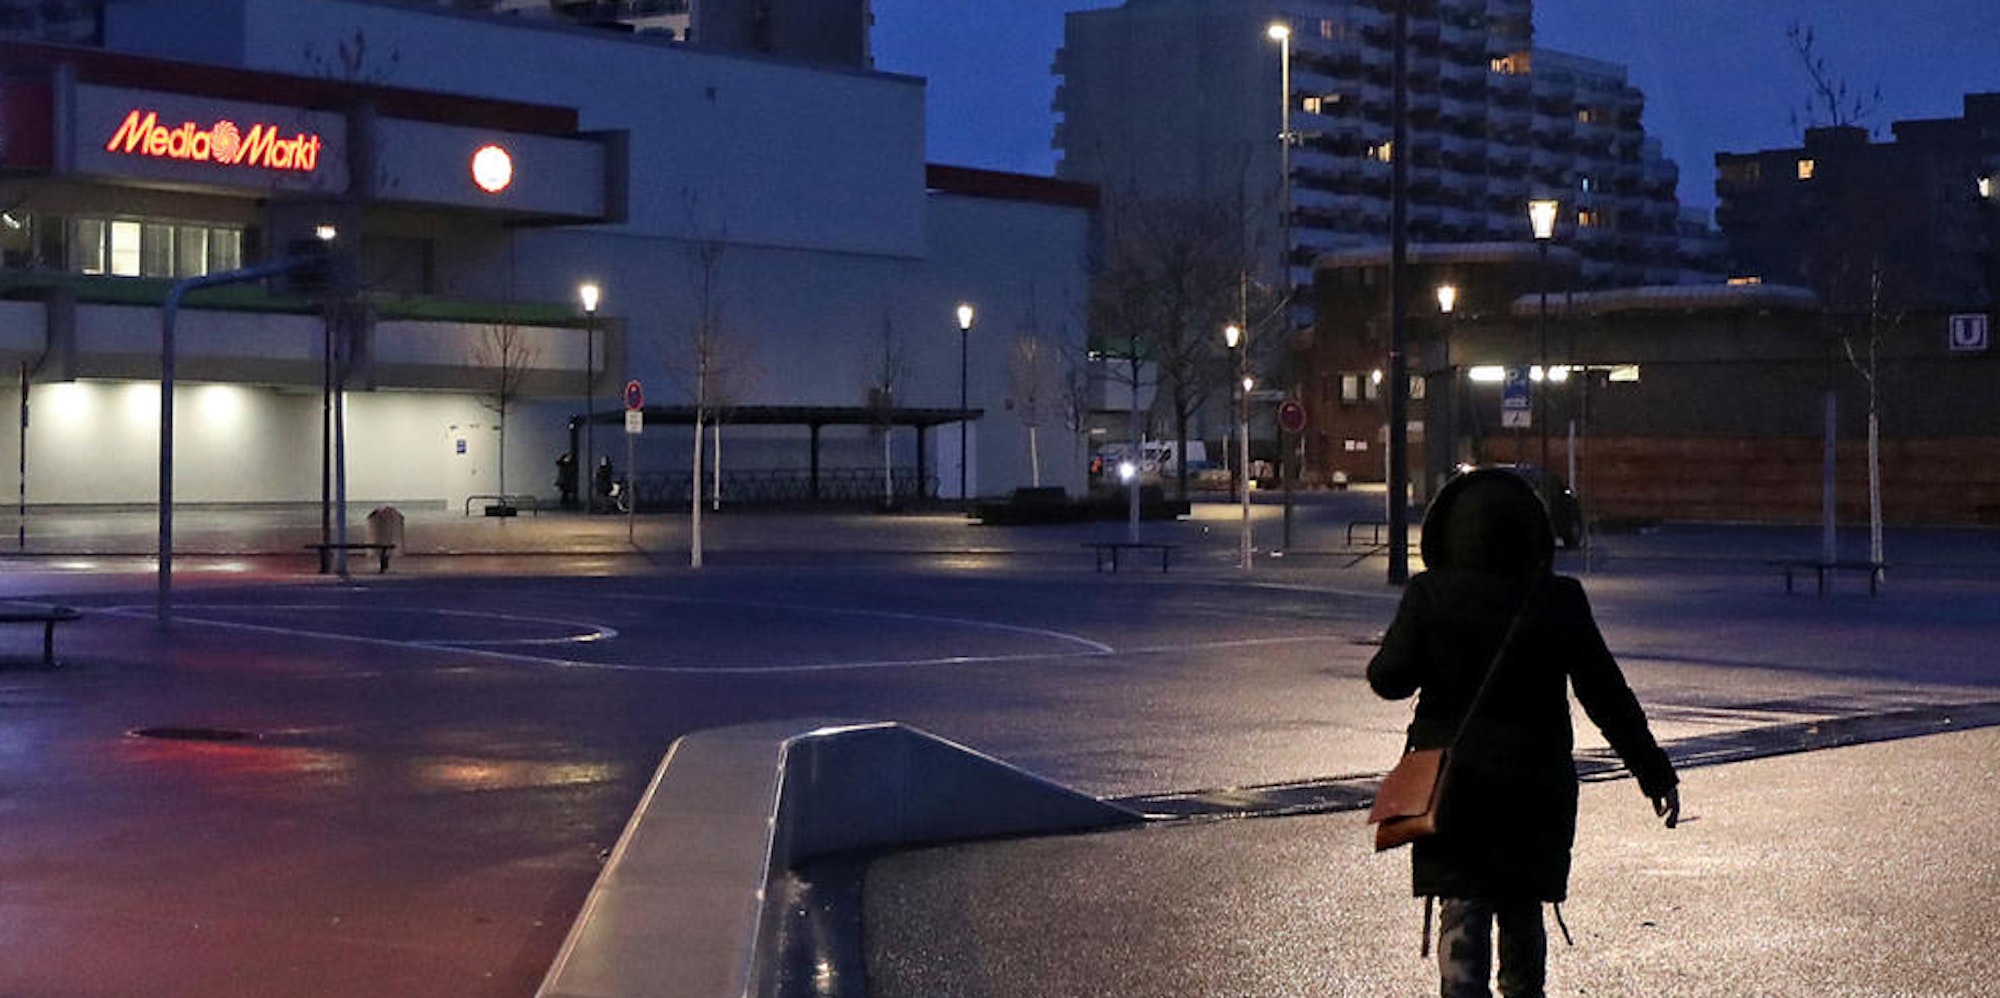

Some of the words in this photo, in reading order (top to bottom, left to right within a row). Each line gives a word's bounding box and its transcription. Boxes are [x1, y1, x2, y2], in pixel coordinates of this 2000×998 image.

[107, 110, 211, 160] Media
[233, 123, 320, 171] Markt
[1955, 319, 1981, 346] U
